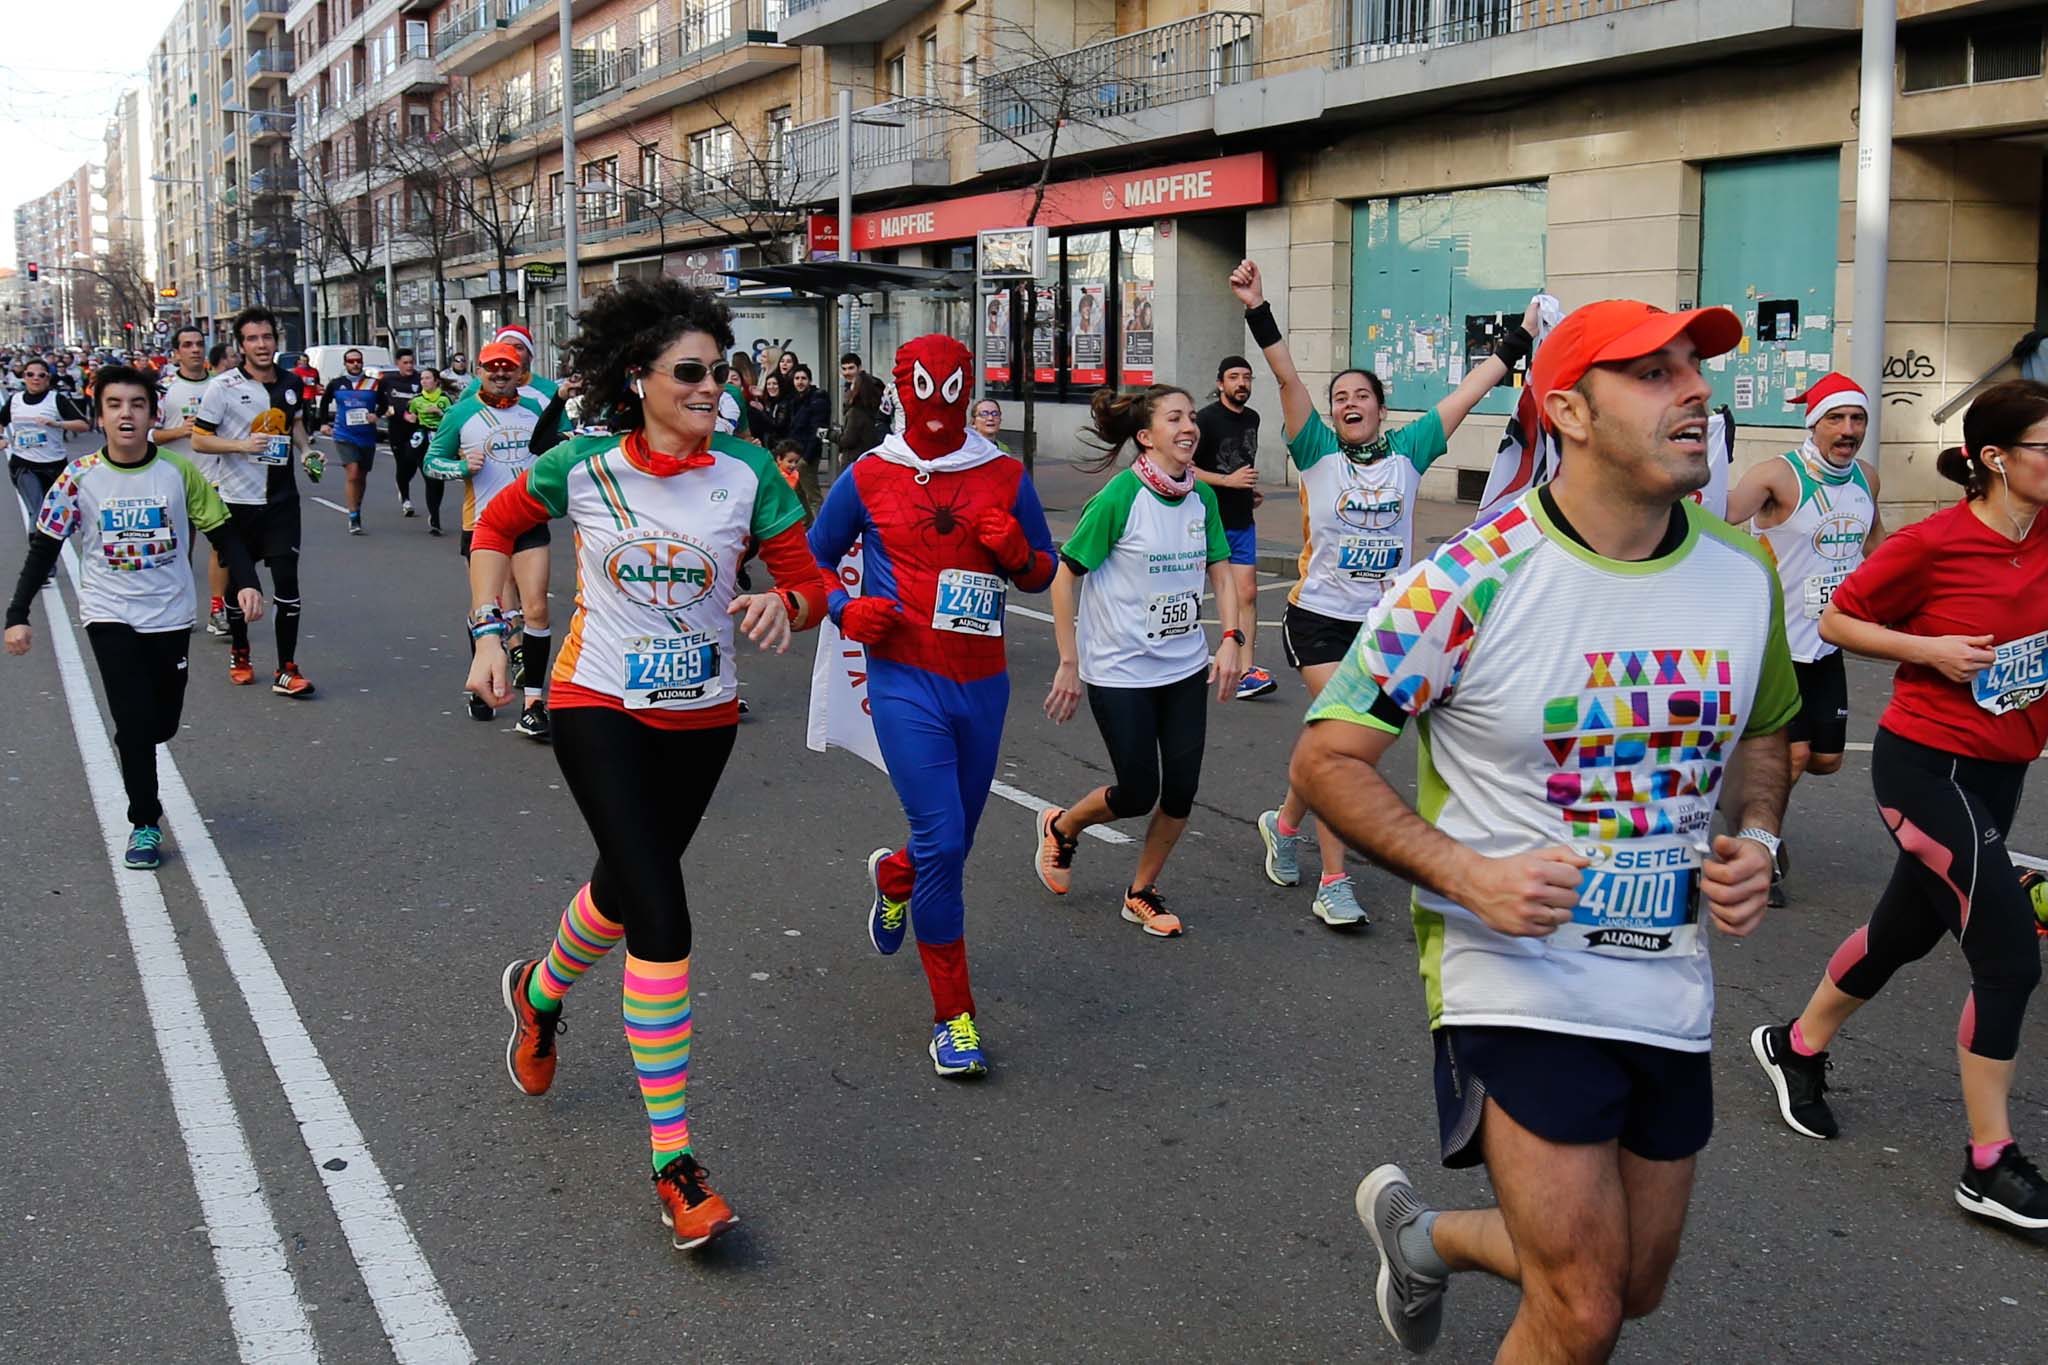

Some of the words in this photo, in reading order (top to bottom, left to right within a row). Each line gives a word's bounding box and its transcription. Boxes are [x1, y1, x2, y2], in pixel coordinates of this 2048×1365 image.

[1124, 170, 1213, 208] MAPFRE
[881, 212, 935, 238] MAPFRE
[117, 499, 160, 507] SETEL
[1344, 499, 1401, 514] ALCER
[112, 509, 150, 529] 5174
[602, 533, 635, 554] CLUB
[643, 530, 719, 560] DEPORTIVO
[1358, 538, 1397, 547] SETEL
[1820, 533, 1864, 545] ALCER
[1346, 548, 1389, 567] 2470
[617, 564, 706, 587] ALCER
[947, 586, 993, 615] 2478
[1161, 602, 1188, 624] 558
[653, 632, 711, 650] SETEL
[1997, 635, 2048, 660] SETE
[638, 648, 702, 684] 2469
[1583, 649, 1732, 689] XXXVI
[1986, 650, 2044, 690] 4205
[656, 690, 697, 700] ALJOMAR
[1543, 690, 1650, 734] SAN
[1667, 690, 1737, 726] SIL
[1562, 807, 1674, 841] TINA
[1614, 846, 1692, 869] SETEL
[1579, 871, 1676, 919] 4000
[1600, 931, 1661, 949] ALJOMAR
